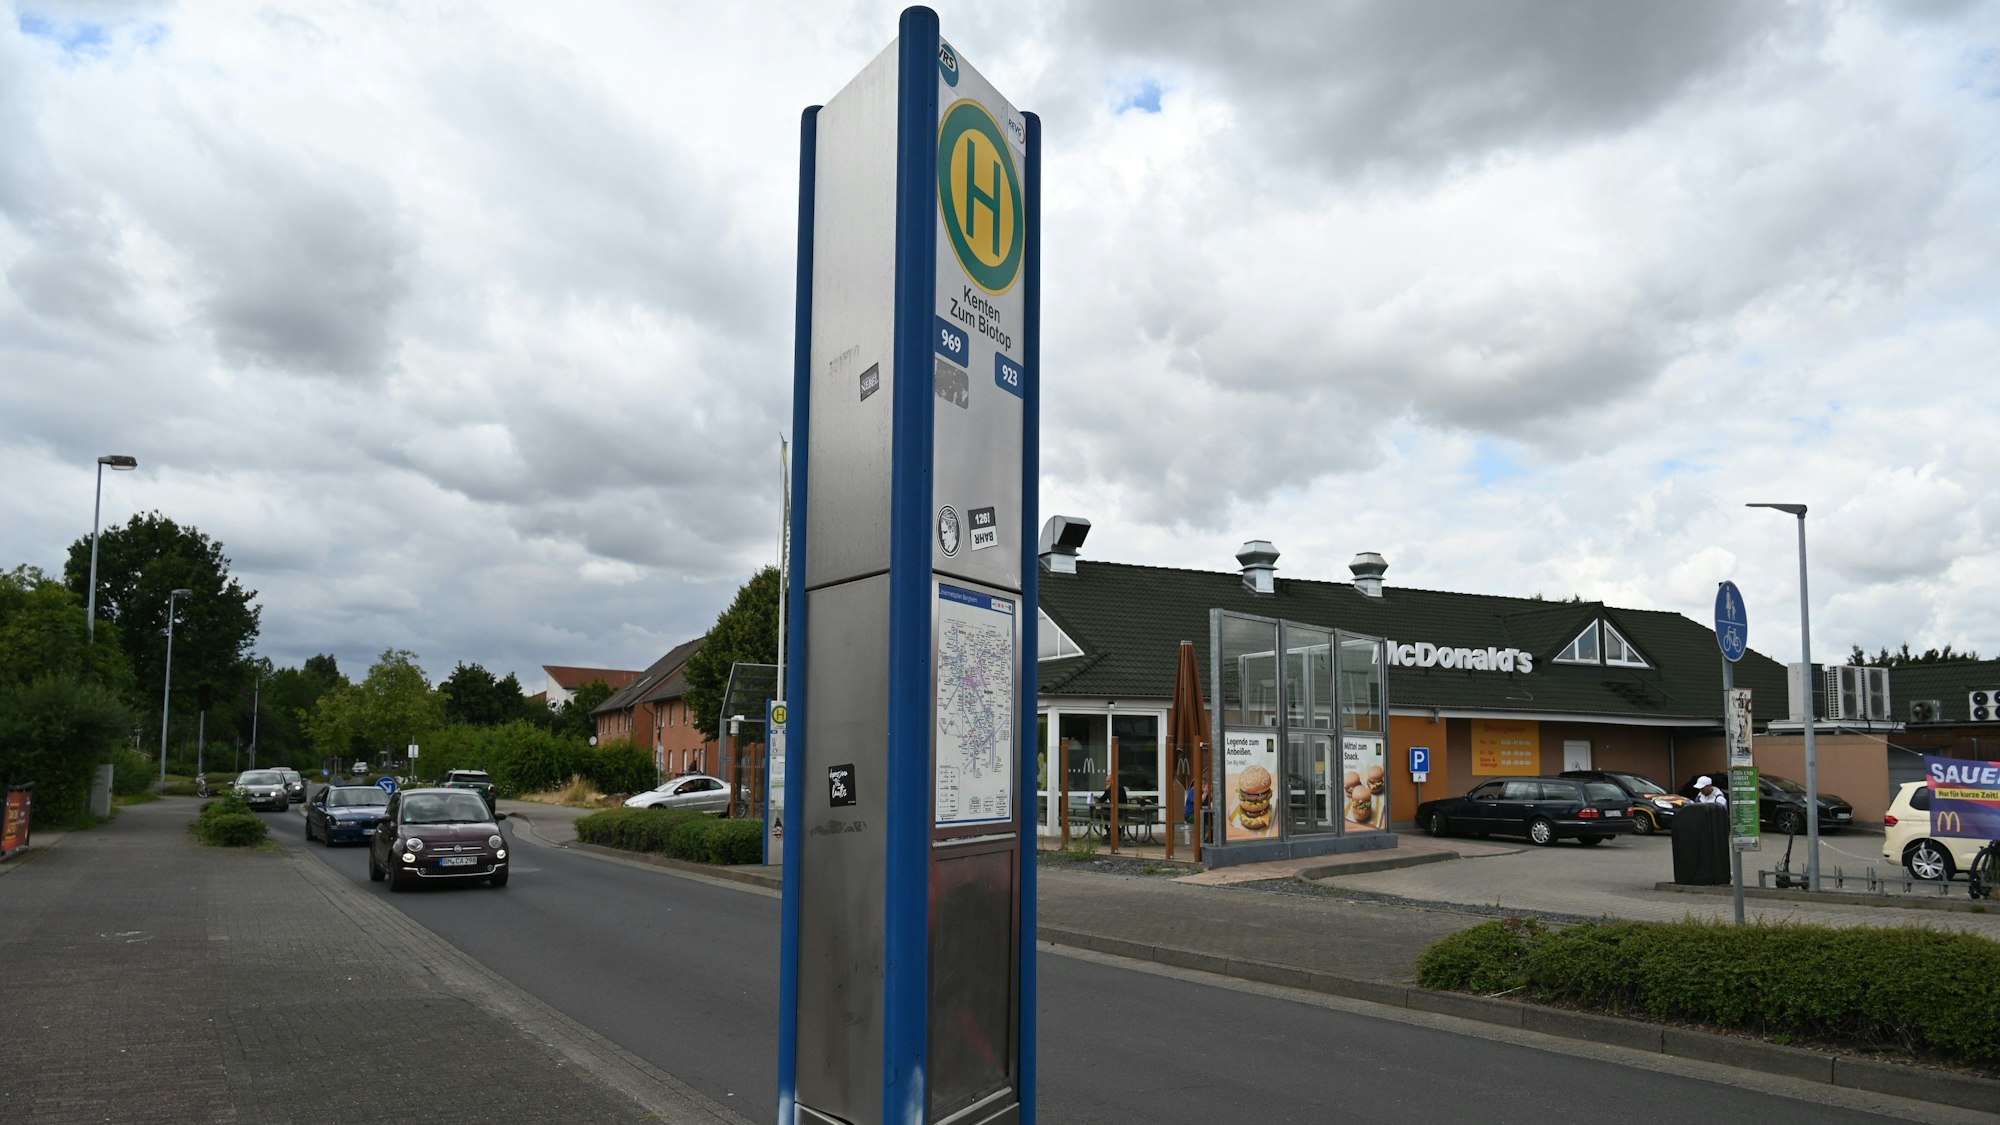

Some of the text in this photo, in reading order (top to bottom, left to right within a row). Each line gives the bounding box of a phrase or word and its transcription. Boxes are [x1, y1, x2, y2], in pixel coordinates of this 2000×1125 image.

[1008, 118, 1022, 137] REVG
[966, 137, 1000, 259] H
[963, 285, 1000, 323] Kenten
[950, 297, 1012, 351] Zum Biotop
[941, 328, 961, 353] 969
[1002, 364, 1018, 387] 923
[974, 531, 994, 544] BAHR
[1372, 640, 1533, 674] McDonald's
[1227, 738, 1248, 747] Legende
[1227, 748, 1251, 756] Anbeißen.
[1344, 741, 1358, 750] Mittel
[1344, 752, 1359, 760] Snack.
[1415, 751, 1425, 770] P
[1931, 763, 2000, 785] SAUE
[1960, 790, 1979, 798] kurze
